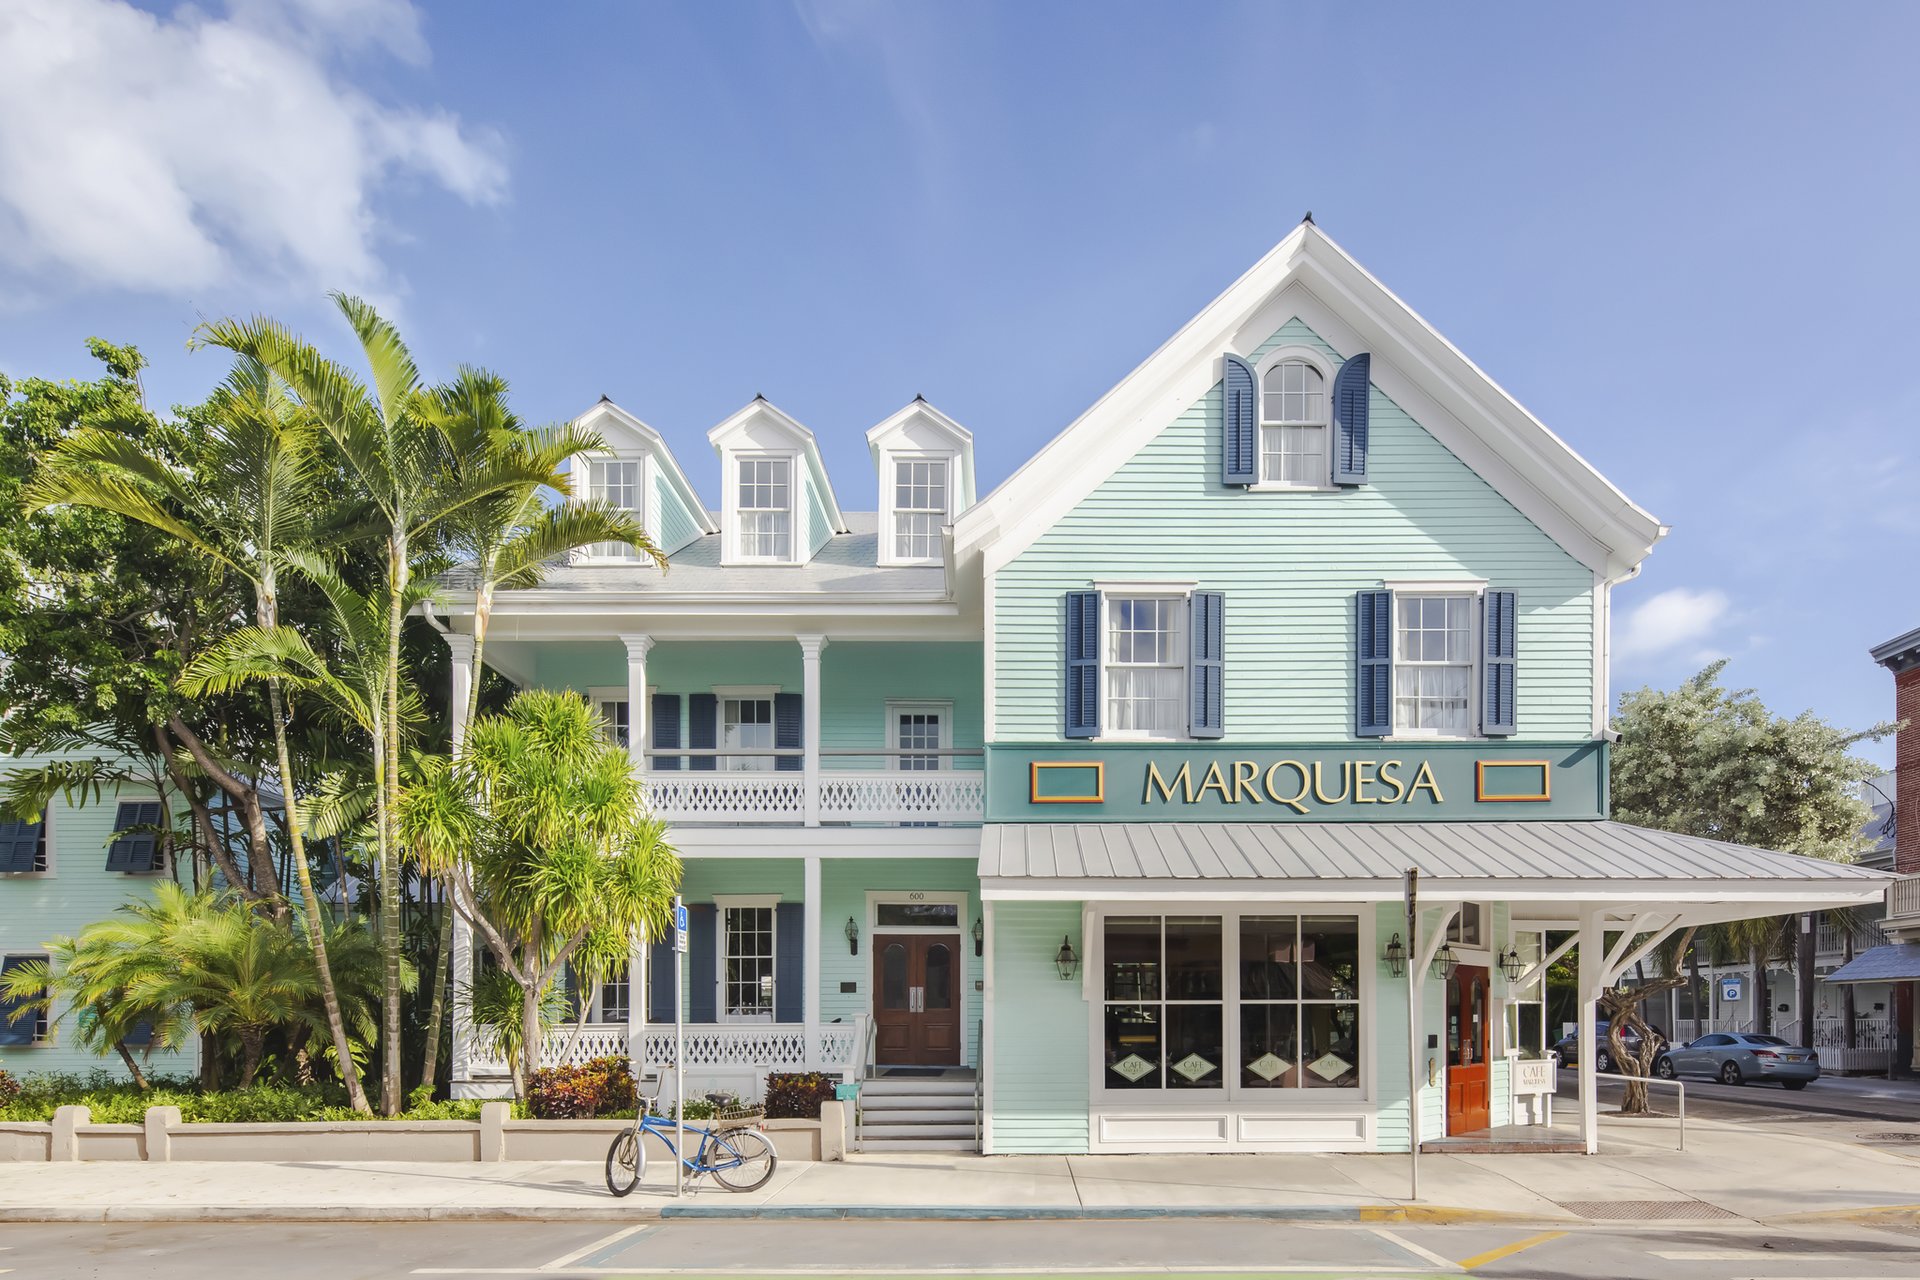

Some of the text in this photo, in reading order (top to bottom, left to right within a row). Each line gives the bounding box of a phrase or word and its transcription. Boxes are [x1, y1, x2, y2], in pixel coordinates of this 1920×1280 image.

[1144, 759, 1445, 814] MARQUESA
[909, 892, 924, 900] 600
[1122, 1061, 1142, 1069] CAFE
